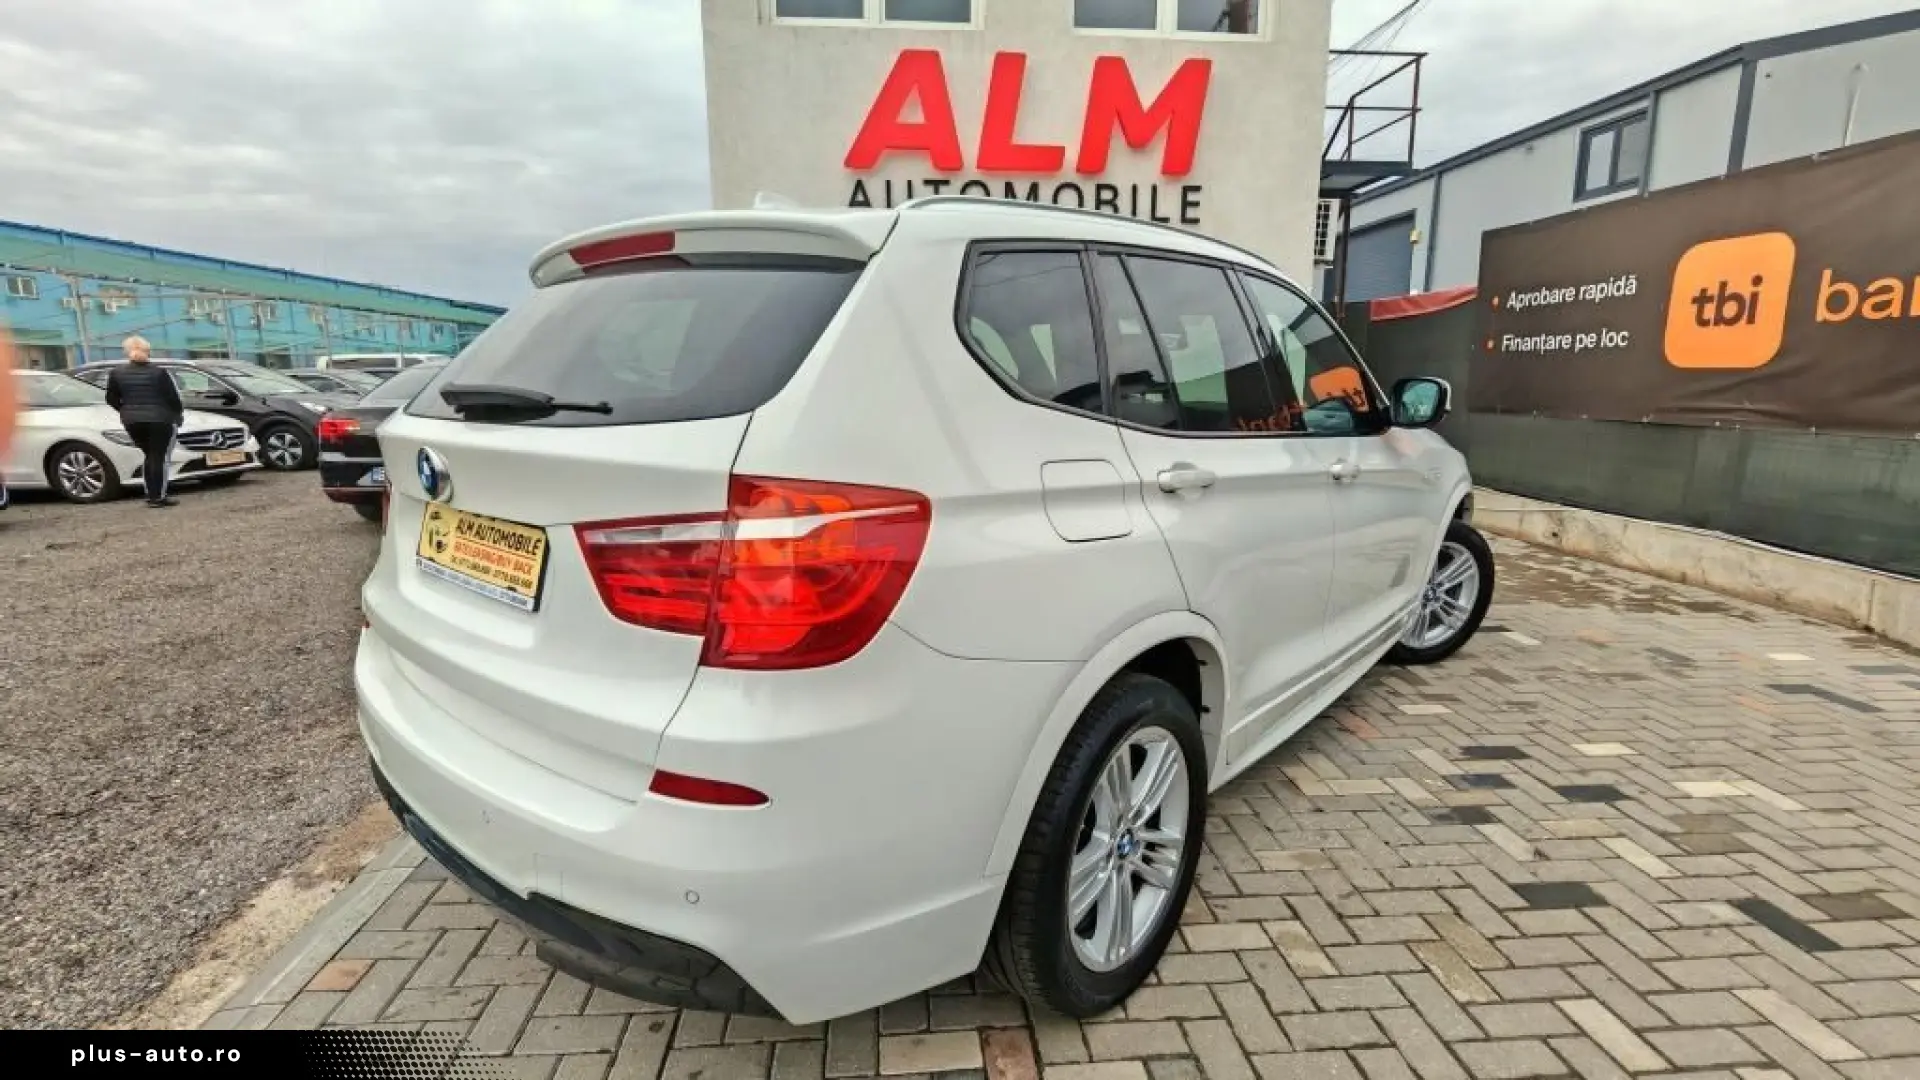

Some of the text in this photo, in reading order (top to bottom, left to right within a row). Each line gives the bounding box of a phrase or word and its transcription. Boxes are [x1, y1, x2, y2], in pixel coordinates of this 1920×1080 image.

[844, 49, 1212, 176] ALM
[1506, 275, 1637, 311] Aprobare rapidă
[1691, 268, 1920, 327] tbi ba
[1574, 331, 1597, 353] pe
[1600, 328, 1629, 347] loc
[475, 522, 542, 556] AUTOMOBILE
